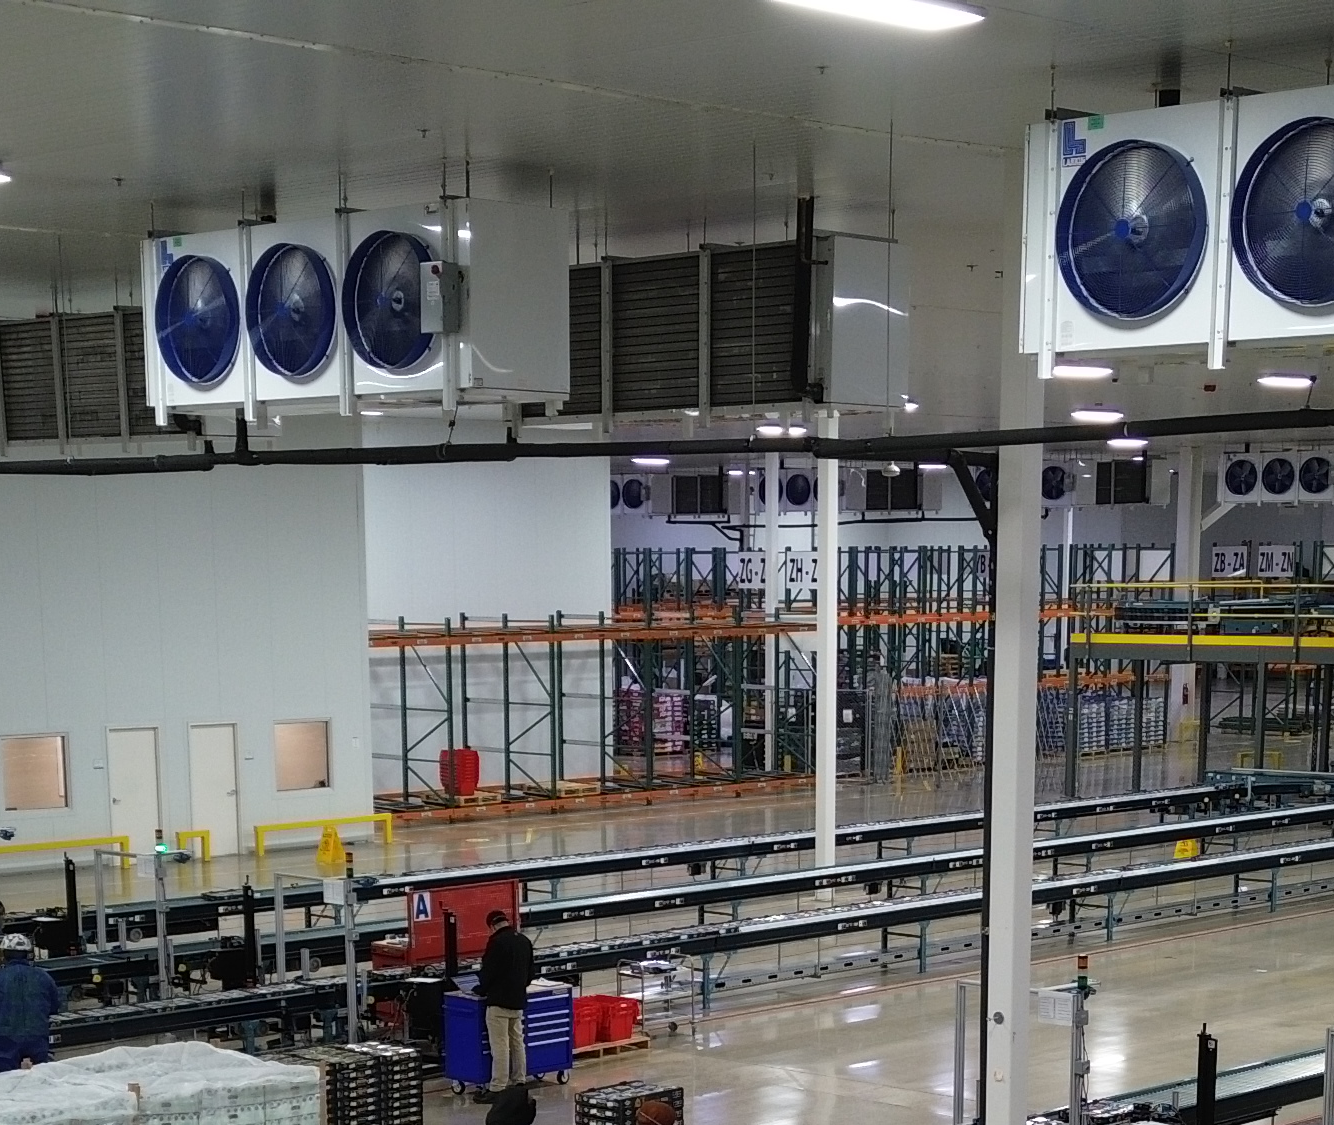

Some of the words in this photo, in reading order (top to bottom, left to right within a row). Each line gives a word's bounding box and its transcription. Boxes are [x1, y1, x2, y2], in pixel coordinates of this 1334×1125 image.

[739, 558, 753, 583] ZG
[789, 558, 803, 583] ZH
[1214, 553, 1226, 572] ZB
[1233, 552, 1245, 572] ZA
[1259, 552, 1273, 572] ZM
[1281, 552, 1294, 572] ZN
[415, 893, 430, 920] A
